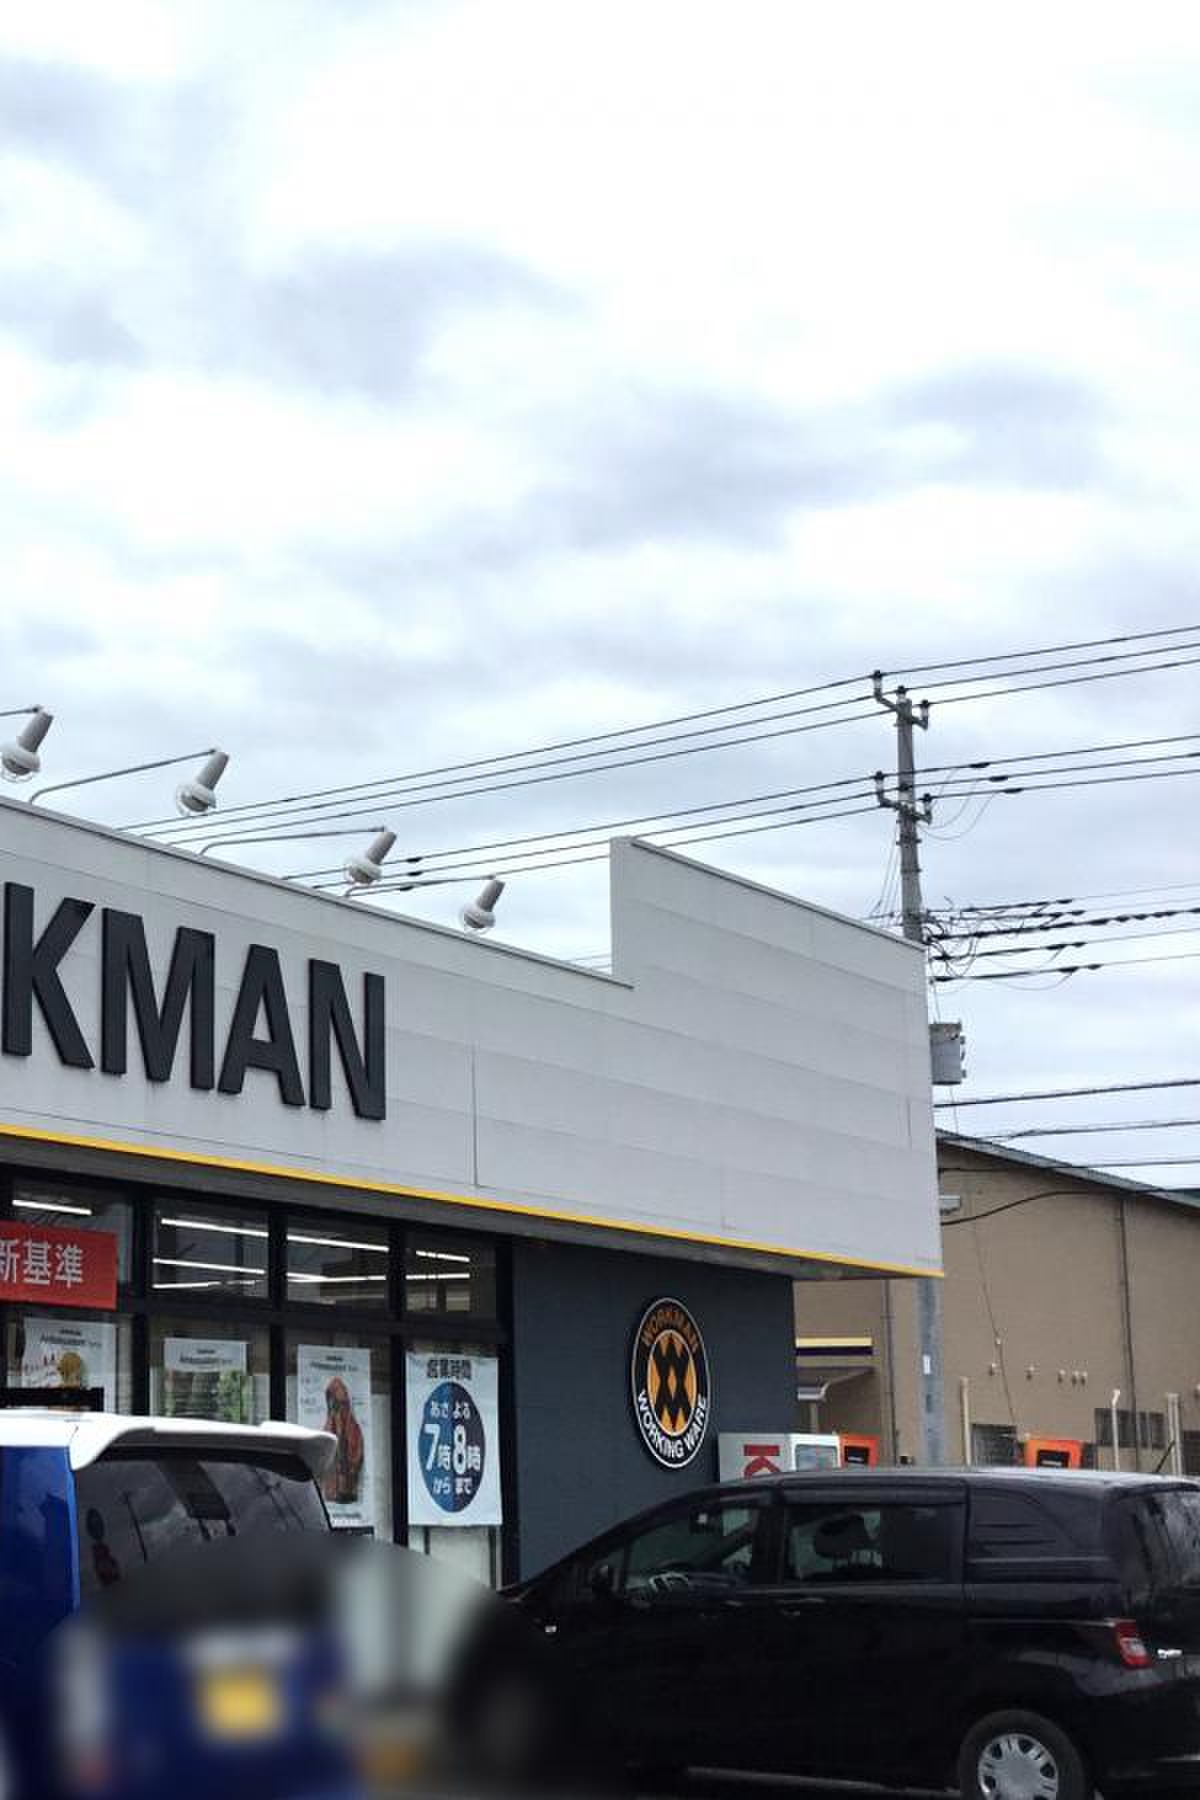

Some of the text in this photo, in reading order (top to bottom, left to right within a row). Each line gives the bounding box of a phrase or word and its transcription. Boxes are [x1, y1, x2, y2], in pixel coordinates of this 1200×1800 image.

[424, 1423, 481, 1475] 7時 8時
[638, 1389, 707, 1459] WORKING WARE
[432, 1477, 473, 1495] から まで
